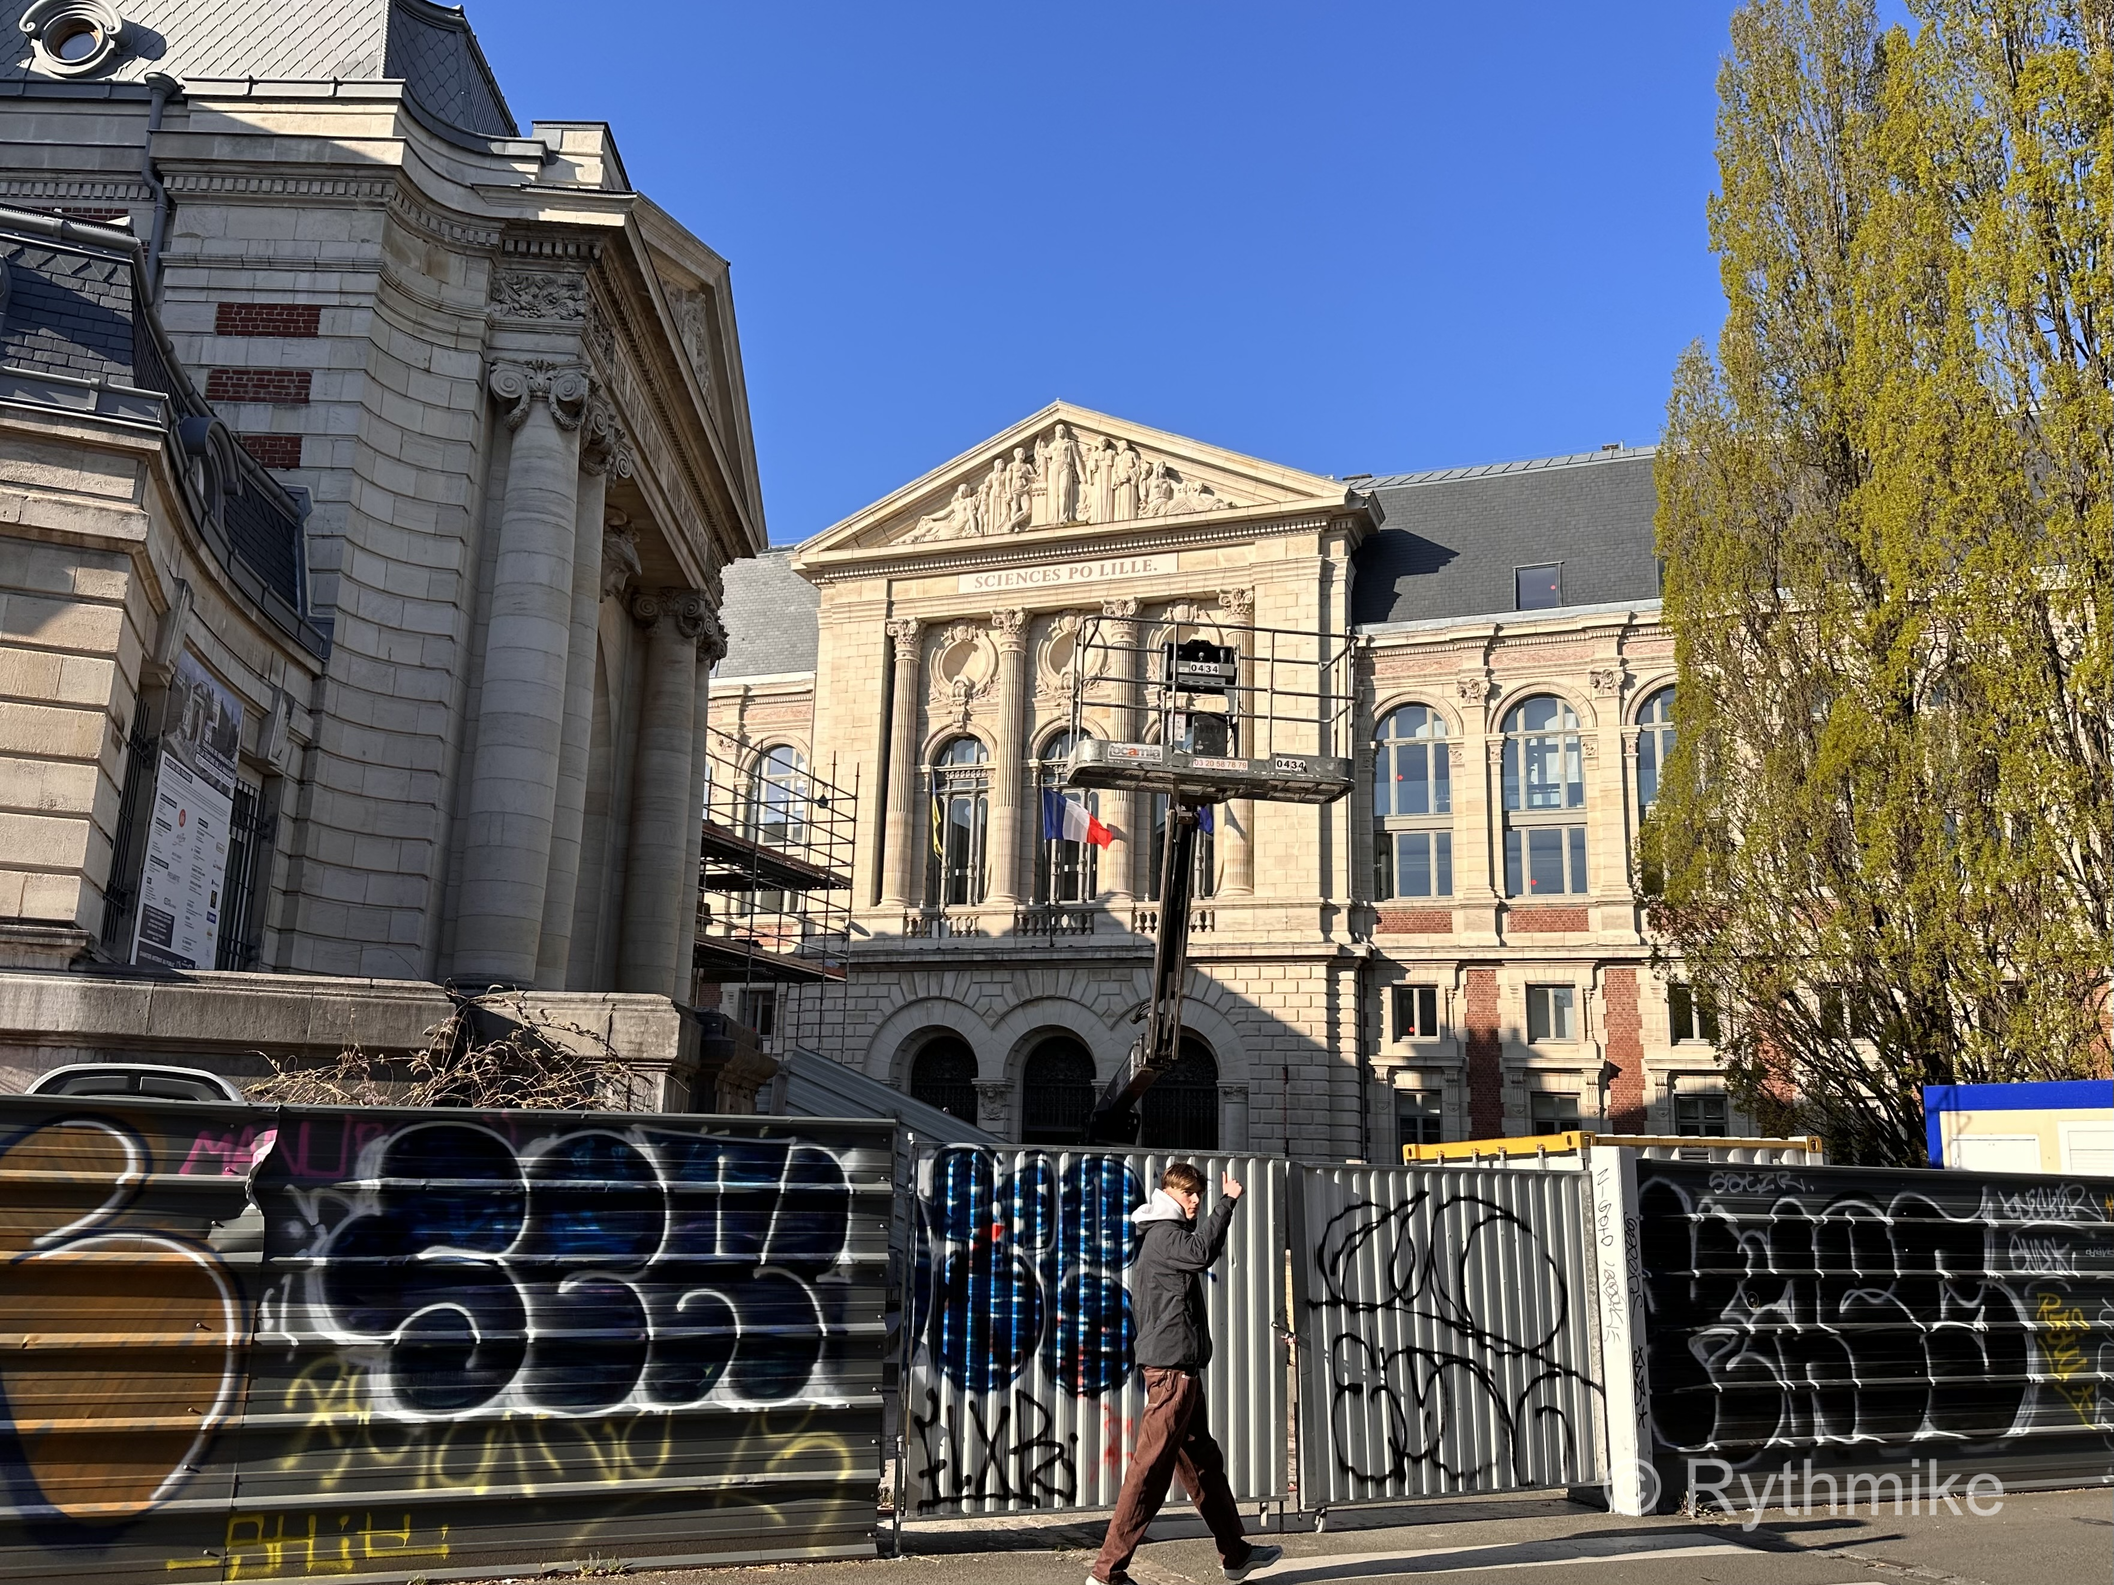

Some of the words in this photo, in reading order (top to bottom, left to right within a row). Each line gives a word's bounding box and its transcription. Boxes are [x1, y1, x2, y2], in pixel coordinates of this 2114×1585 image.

[974, 568, 1061, 589] SCIENCES
[1069, 565, 1093, 580] PO
[1100, 559, 1158, 577] LILLE.
[1191, 664, 1219, 673] 0434
[1205, 759, 1215, 767] 20
[1277, 760, 1305, 770] 0434
